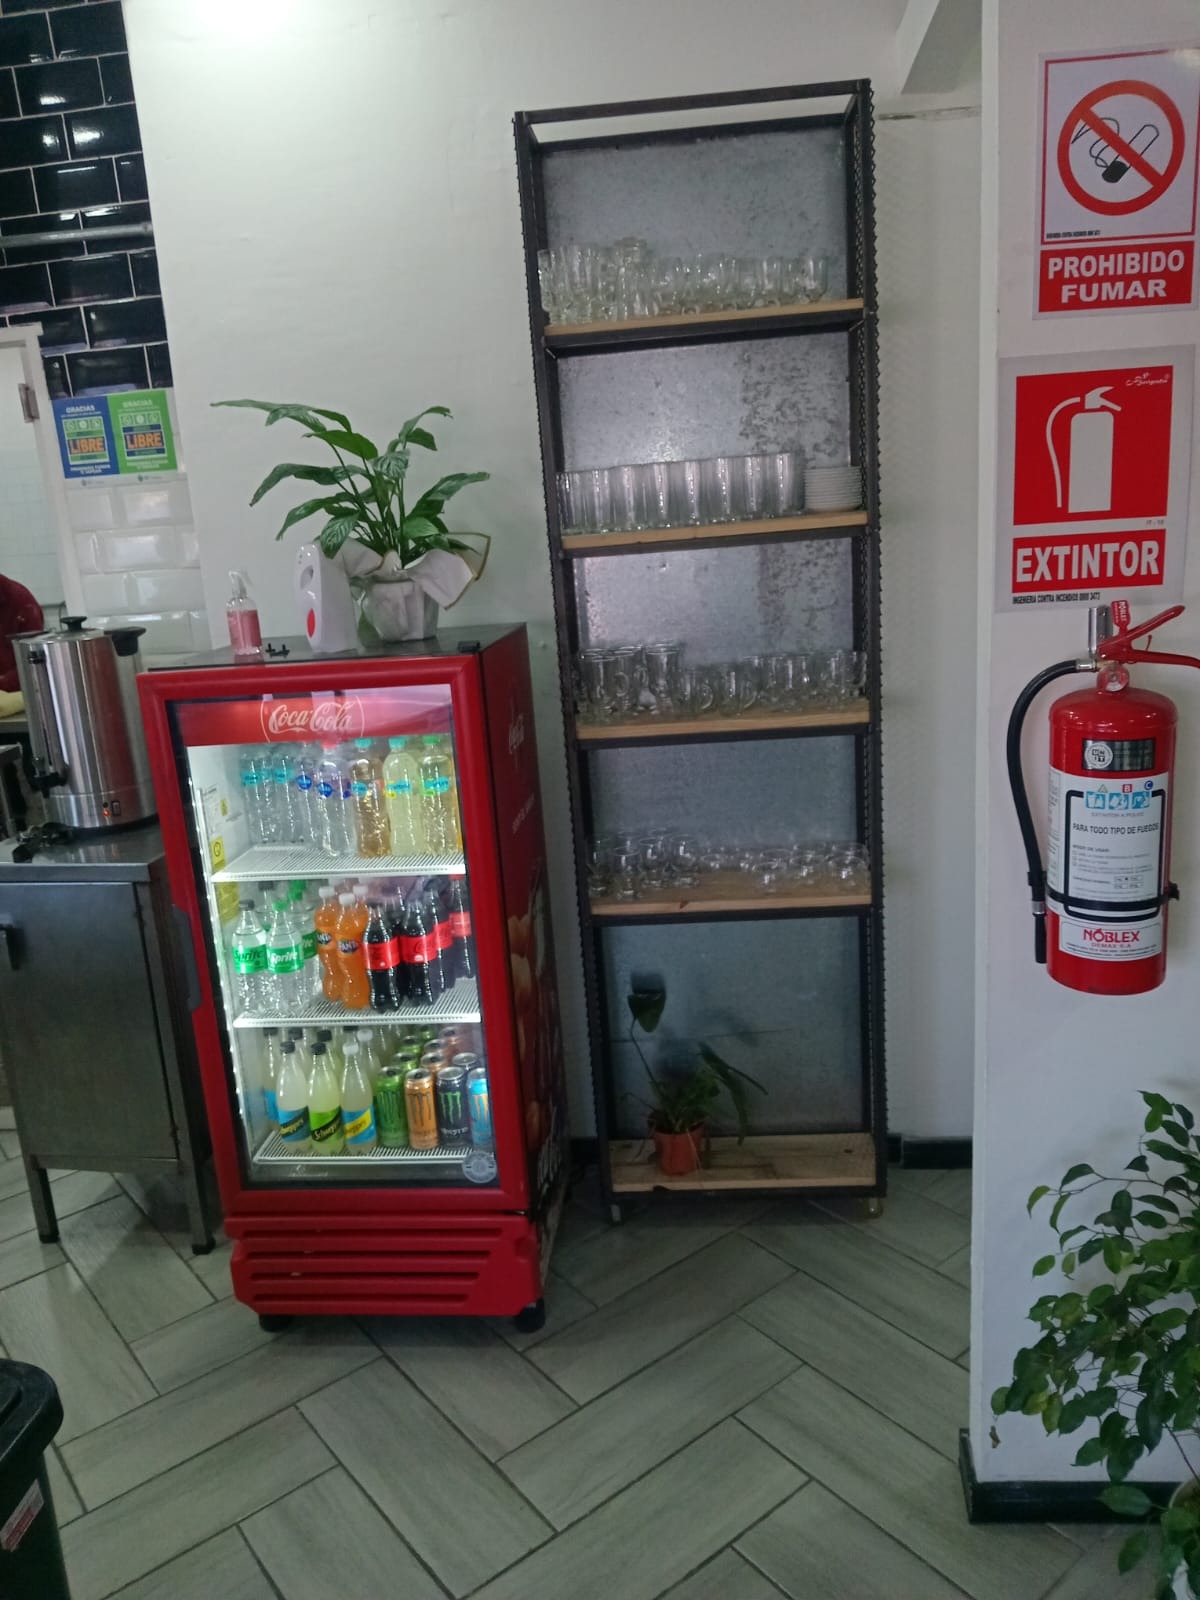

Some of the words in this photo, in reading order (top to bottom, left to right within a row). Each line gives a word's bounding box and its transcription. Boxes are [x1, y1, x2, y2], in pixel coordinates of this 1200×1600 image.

[1048, 249, 1184, 279] PROHIBIDO
[1061, 279, 1167, 304] FUMAR
[69, 437, 105, 455] LIBRE
[126, 433, 162, 450] LIBRE
[1016, 540, 1160, 583] EXTINTOR
[1089, 826, 1108, 835] TODO
[1110, 827, 1126, 835] TIPO
[1127, 826, 1136, 835] DE
[1083, 928, 1140, 943] NOBLEX
[234, 950, 264, 961] Sprite
[271, 951, 298, 963] Sprite
